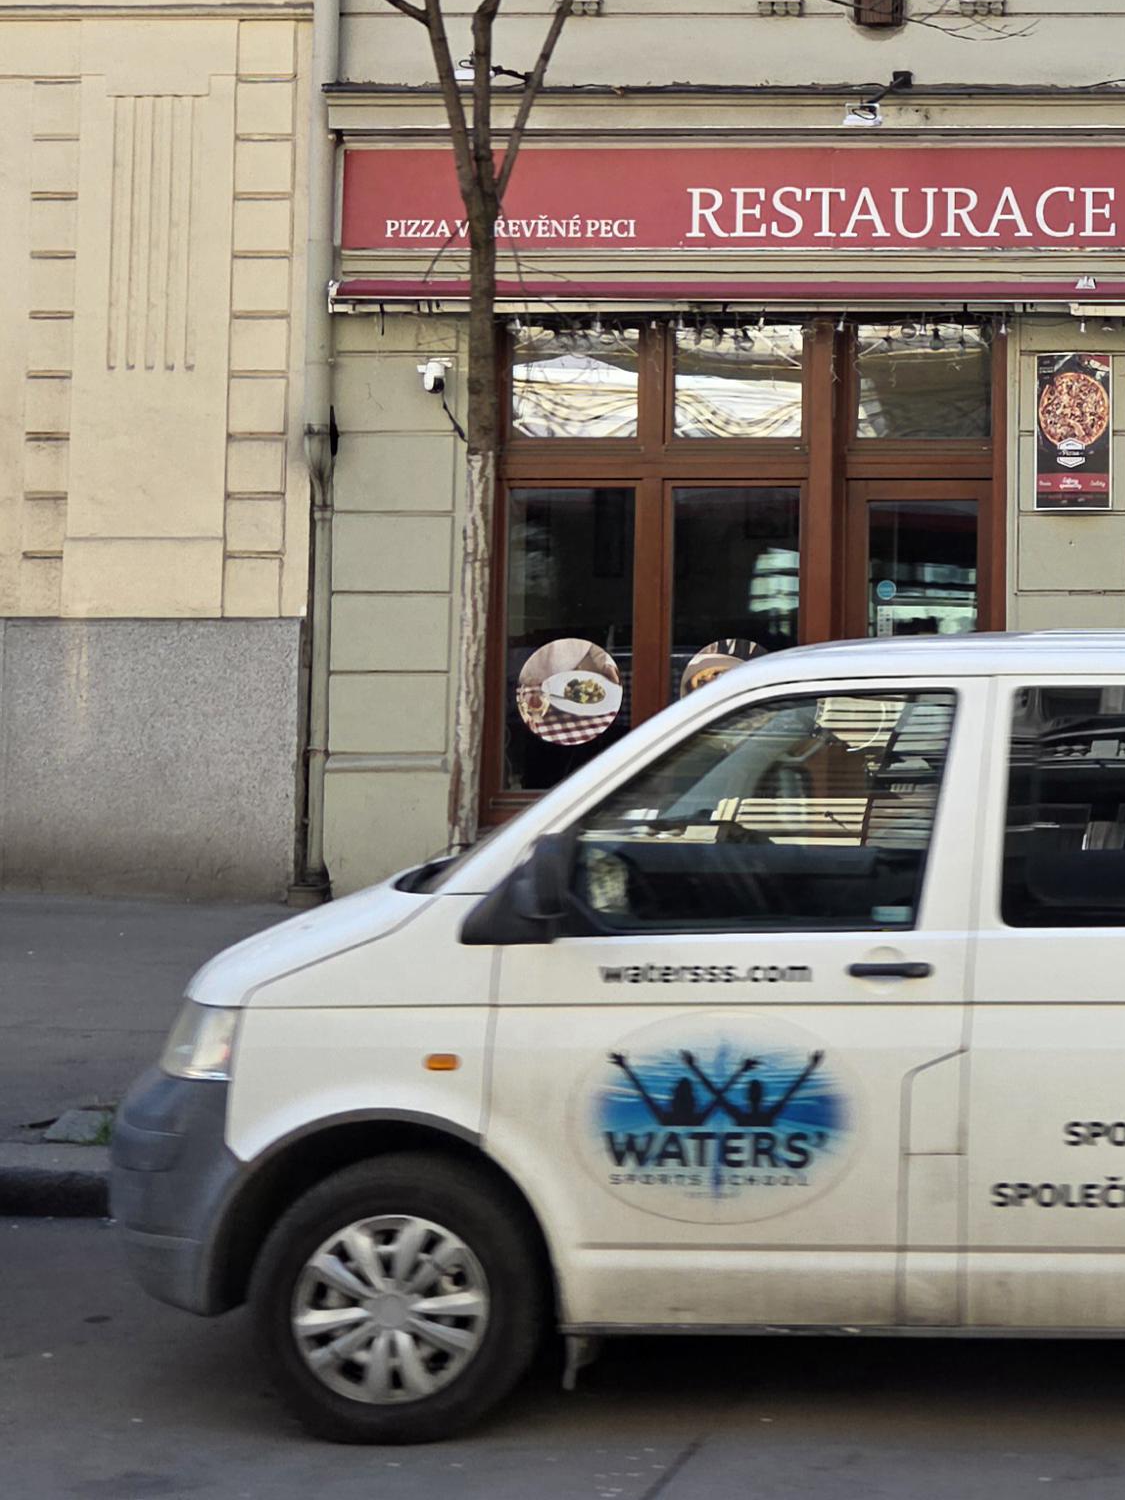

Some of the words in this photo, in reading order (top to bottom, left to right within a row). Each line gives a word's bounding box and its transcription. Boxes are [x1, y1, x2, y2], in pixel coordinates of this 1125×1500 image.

[384, 219, 452, 238] PIZZA
[454, 219, 471, 238] V
[490, 214, 582, 238] ŘEVĚNÉ
[586, 219, 637, 238] PECI
[684, 185, 1116, 239] RESTAURACE
